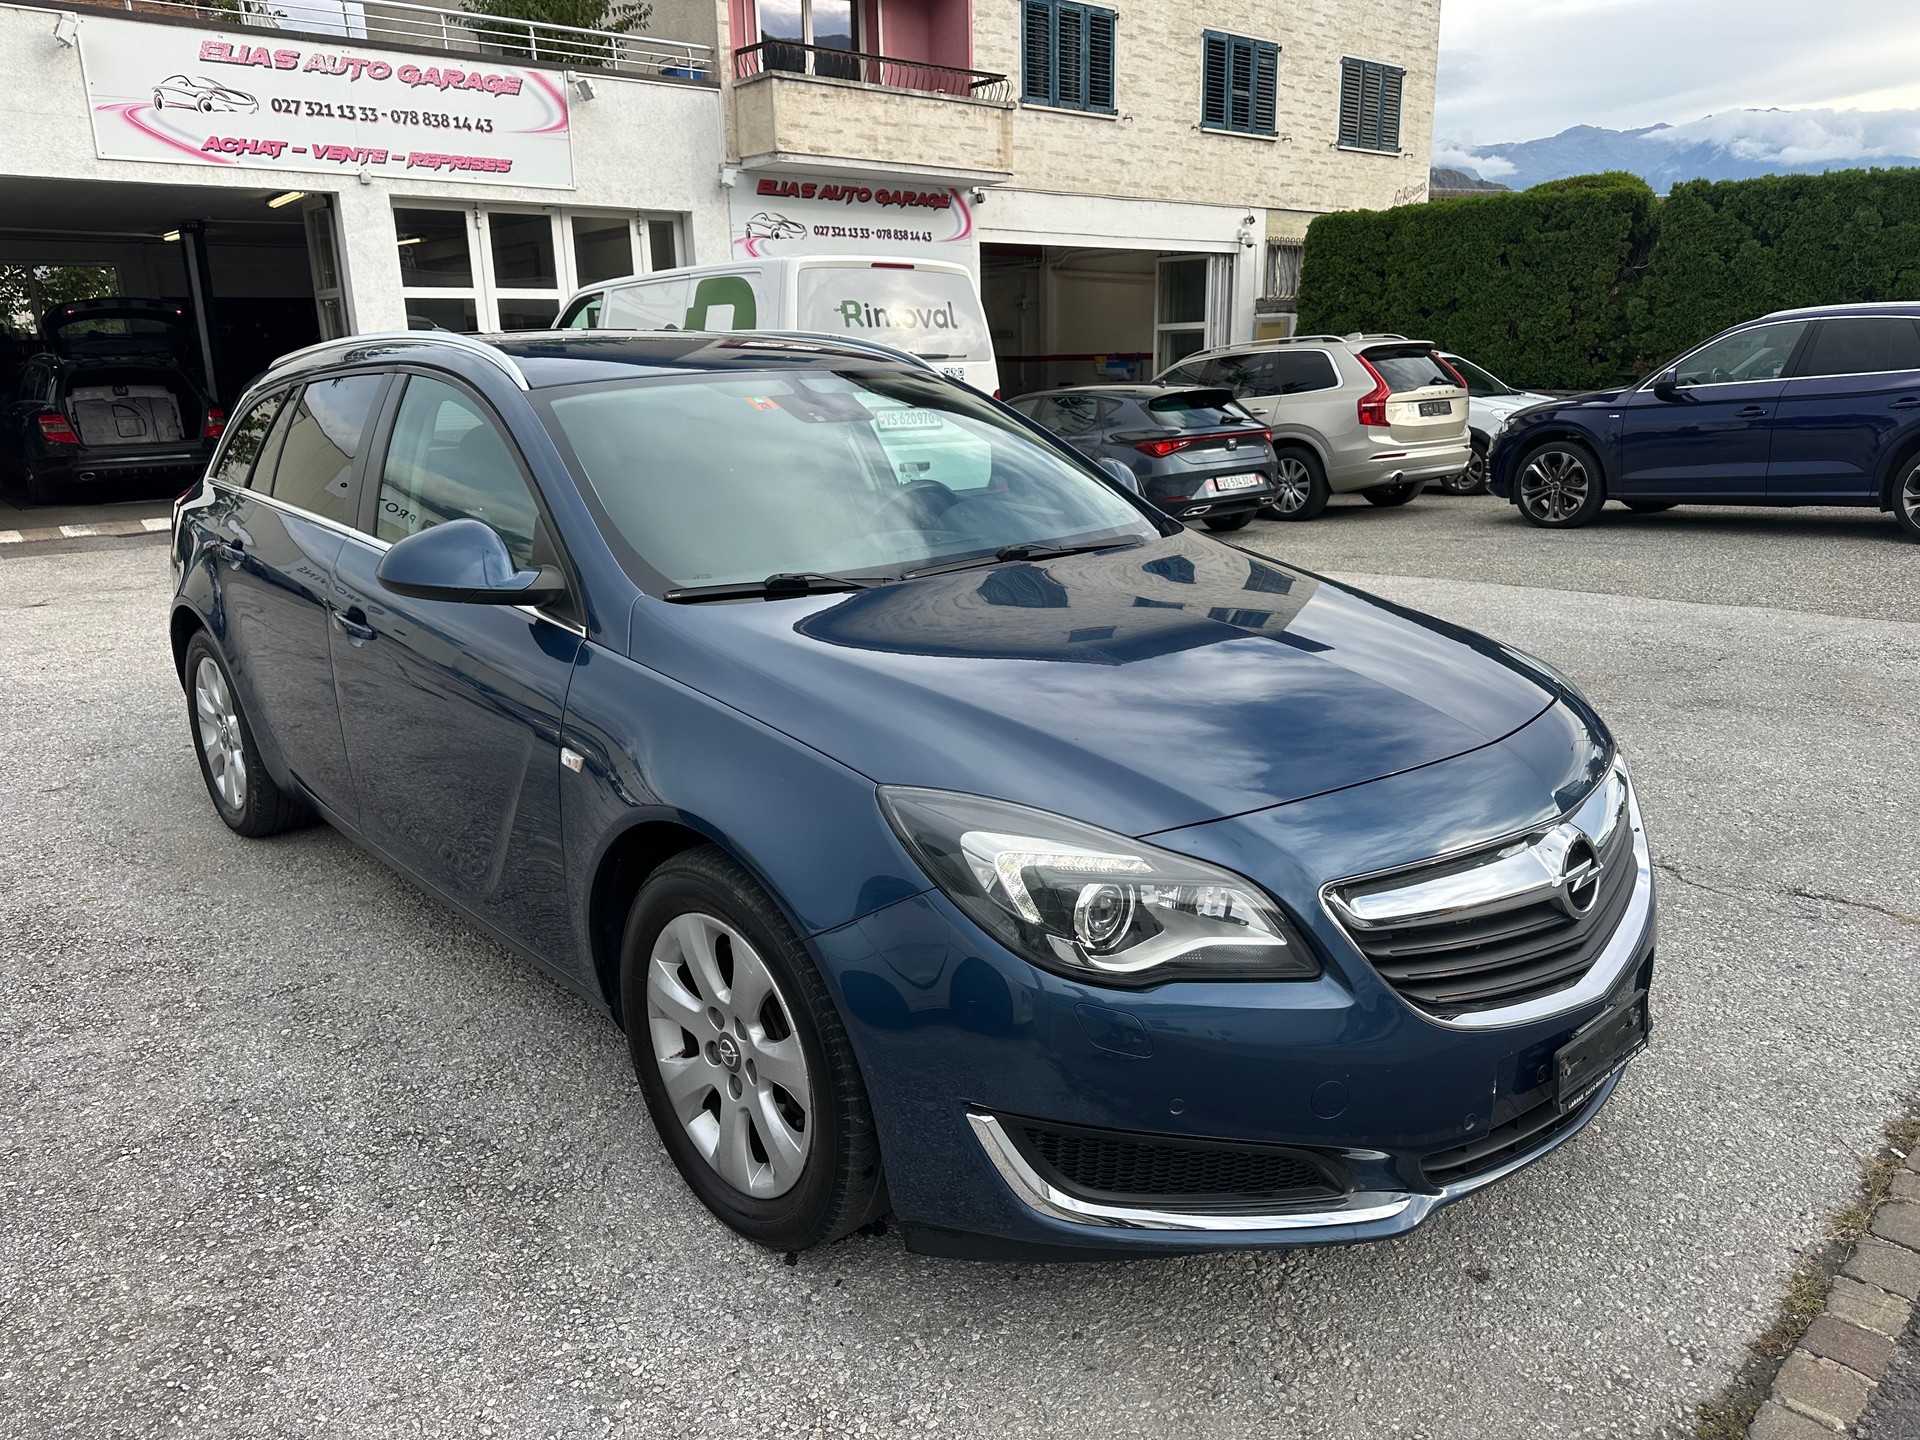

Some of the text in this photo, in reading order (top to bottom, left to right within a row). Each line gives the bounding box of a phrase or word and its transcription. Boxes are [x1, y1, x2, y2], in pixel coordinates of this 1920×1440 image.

[199, 40, 523, 98] ELIAS AUTO GARAGE
[271, 97, 300, 115] 027
[305, 101, 334, 118] 321
[338, 105, 356, 120] 13
[359, 107, 379, 123] 33
[390, 109, 419, 126] 078
[422, 112, 450, 128] 838
[453, 116, 472, 131] 14
[475, 118, 494, 133] 43
[201, 136, 287, 159] ACHAT
[311, 144, 389, 166] VENTE
[407, 152, 513, 173] REPRISES
[757, 179, 952, 211] ELIAS AUTO GARAGE
[813, 226, 829, 237] 027
[831, 227, 847, 238] 321
[849, 228, 859, 238] 13
[860, 229, 870, 239] 33
[876, 231, 892, 240] 078
[893, 232, 909, 241] 838
[910, 232, 921, 242] 14
[922, 233, 932, 242] 43
[884, 412, 935, 426] VS 620970
